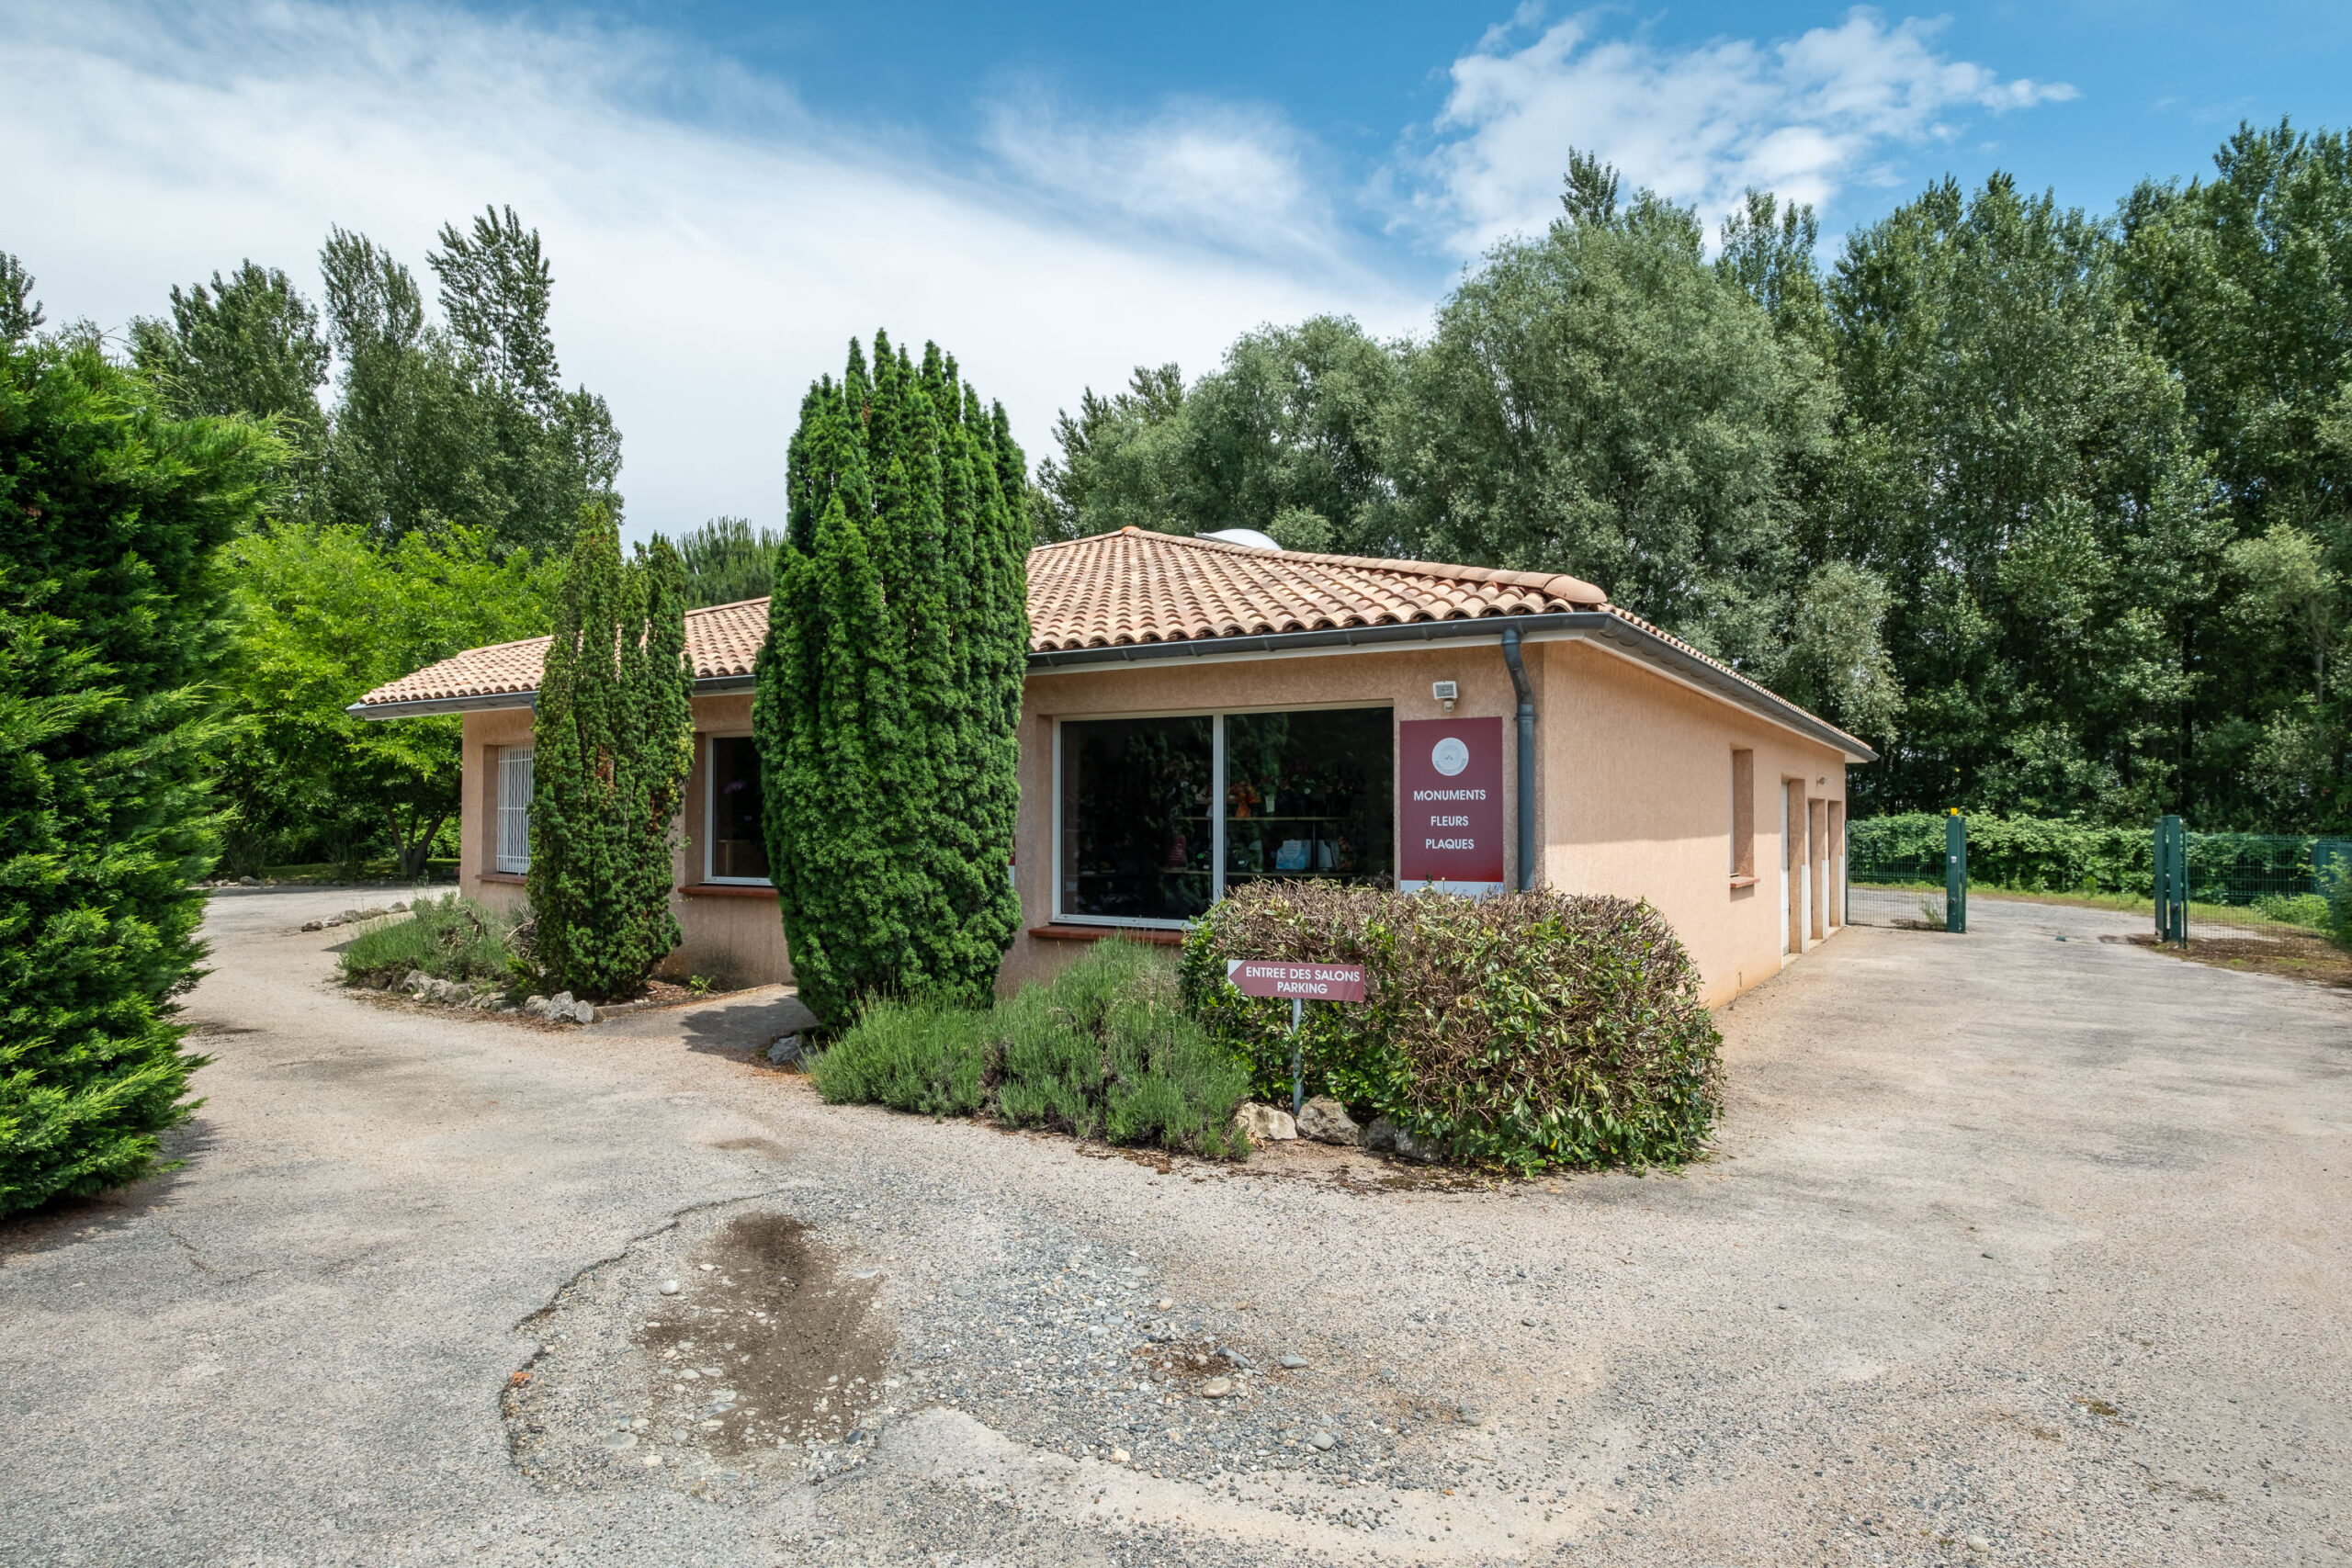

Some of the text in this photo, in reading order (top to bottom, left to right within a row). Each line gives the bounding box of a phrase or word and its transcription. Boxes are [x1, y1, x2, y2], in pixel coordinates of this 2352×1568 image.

[1413, 789, 1486, 801] MONUMENTS
[1430, 816, 1469, 827] FLEURS
[1425, 839, 1475, 850] PLAQUES
[1246, 966, 1361, 982] ENTREE DES SALONS
[1277, 981, 1328, 994] PARKING
